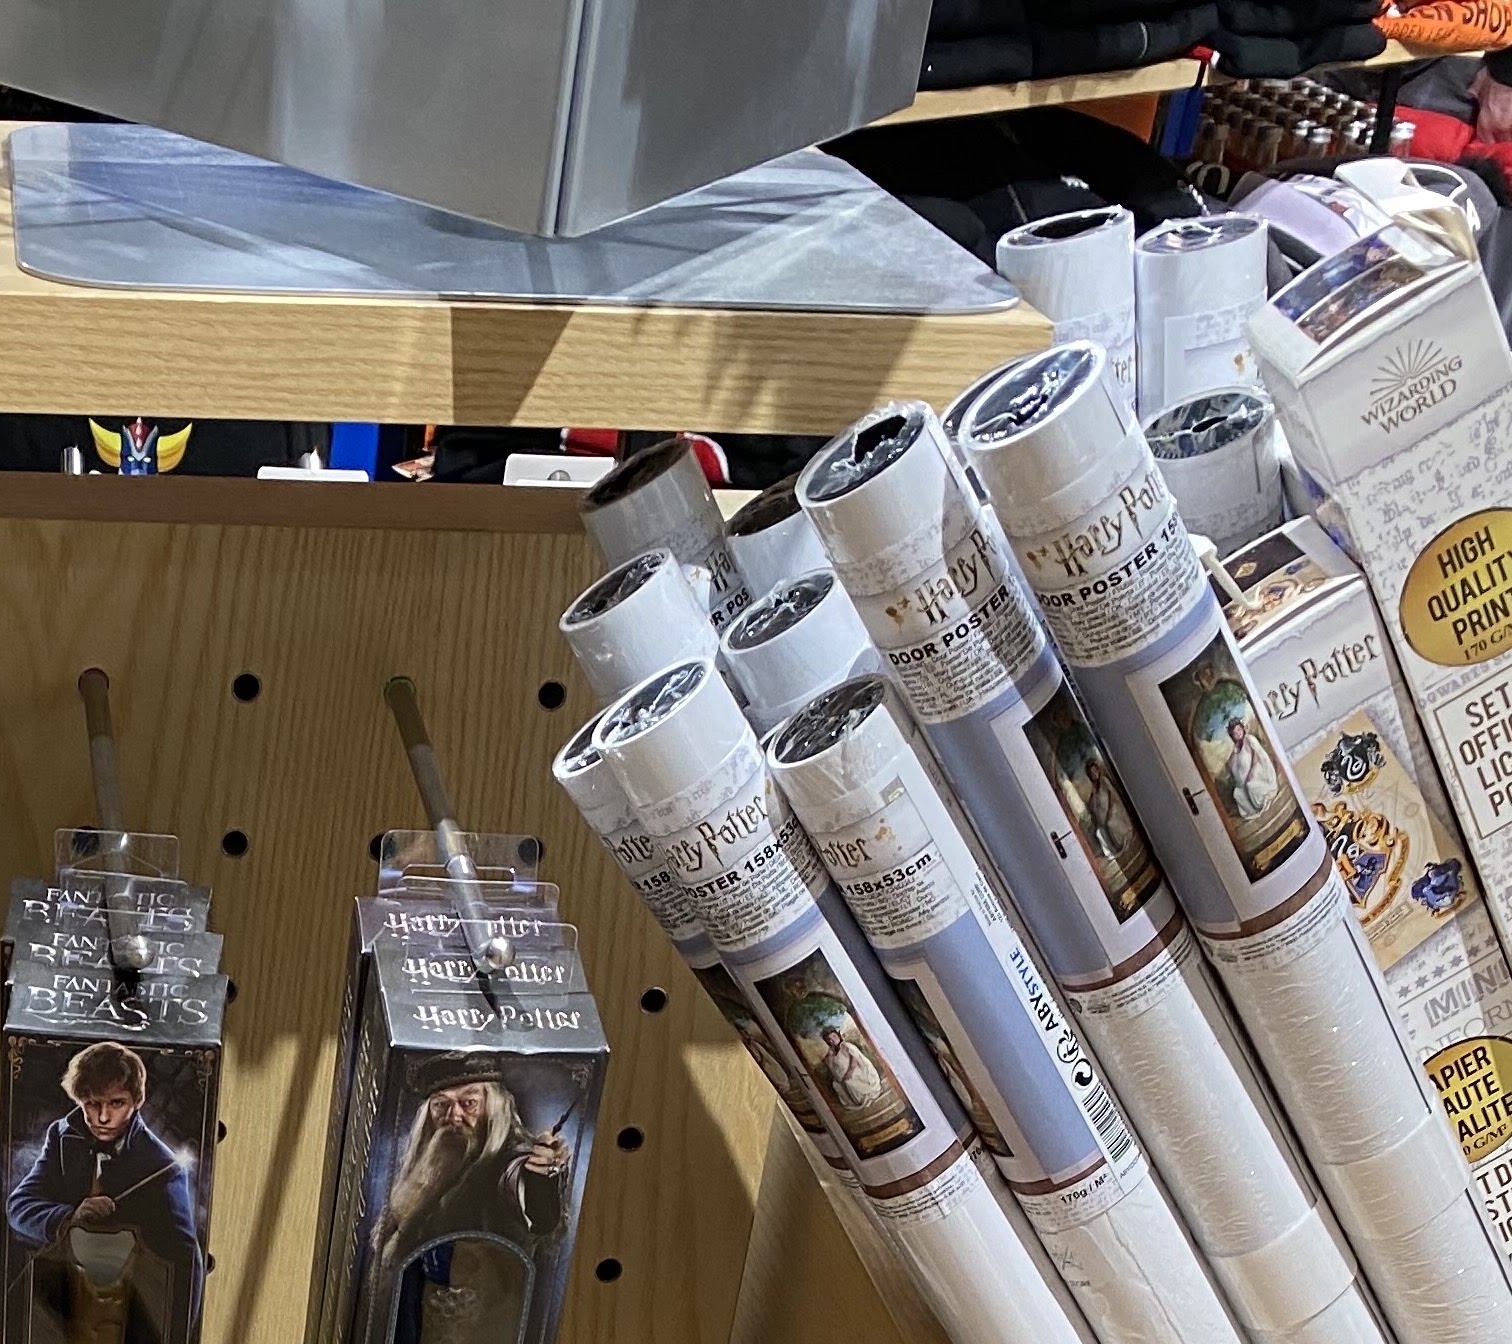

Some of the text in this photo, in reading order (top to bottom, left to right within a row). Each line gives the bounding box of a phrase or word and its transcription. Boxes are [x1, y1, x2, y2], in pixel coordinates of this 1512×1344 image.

[1360, 355, 1464, 428] WIZARDING
[1377, 378, 1458, 435] WORLD
[1052, 509, 1124, 579] Harry
[1437, 525, 1497, 580] HIGH
[914, 556, 980, 626] Harry
[1080, 542, 1159, 602] POSTER
[1426, 550, 1512, 622] QUALIT
[888, 644, 939, 666] DOOR
[942, 584, 1010, 648] POSTER
[1298, 633, 1382, 710] Potter
[1463, 638, 1488, 662] 170
[1465, 681, 1512, 728] SET
[697, 795, 770, 868] Potter
[46, 887, 177, 906] FANTTIC
[846, 851, 934, 896] 158x53cm
[22, 899, 196, 933] BEATS
[488, 914, 544, 938] otter
[28, 941, 204, 978] BEATS
[504, 961, 566, 985] otter
[22, 985, 210, 1027] BEASTS
[52, 974, 190, 997] FANTASTIC
[1008, 946, 1060, 1033] ABYSTYLE
[412, 1004, 582, 1033] Harry Potter
[1443, 1071, 1501, 1119] AUTE
[1456, 1092, 1512, 1143] ALITE
[1060, 1189, 1089, 1205] 170g
